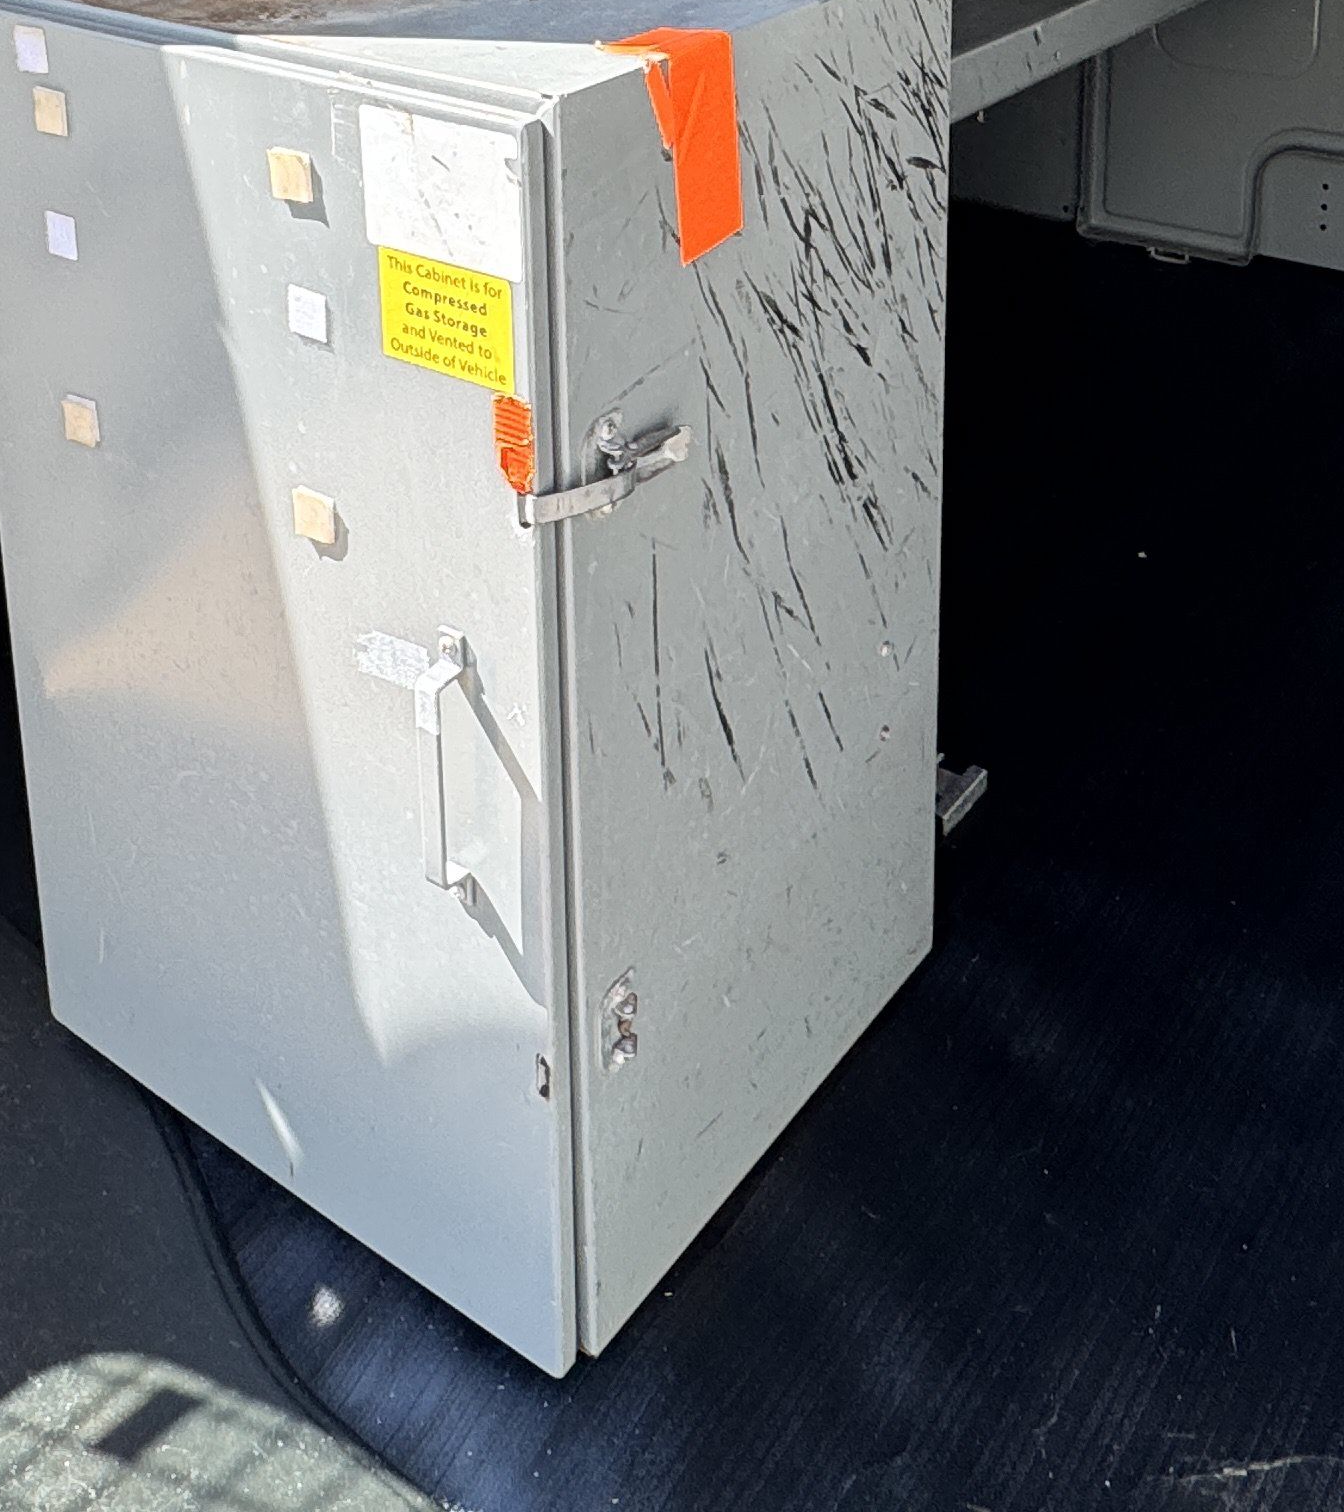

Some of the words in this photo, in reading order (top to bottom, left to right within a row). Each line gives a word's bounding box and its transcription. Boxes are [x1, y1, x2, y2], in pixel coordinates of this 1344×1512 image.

[387, 255, 412, 275] This
[416, 264, 466, 290] Cabinet
[483, 282, 502, 299] for
[402, 281, 488, 316] Compressed
[405, 302, 430, 320] Gas
[434, 311, 488, 338] Storage
[402, 323, 426, 339] and
[429, 328, 474, 354] Vented
[479, 343, 493, 360] to
[390, 337, 440, 364] Outside
[443, 355, 456, 368] of
[459, 360, 507, 386] Vehicle
